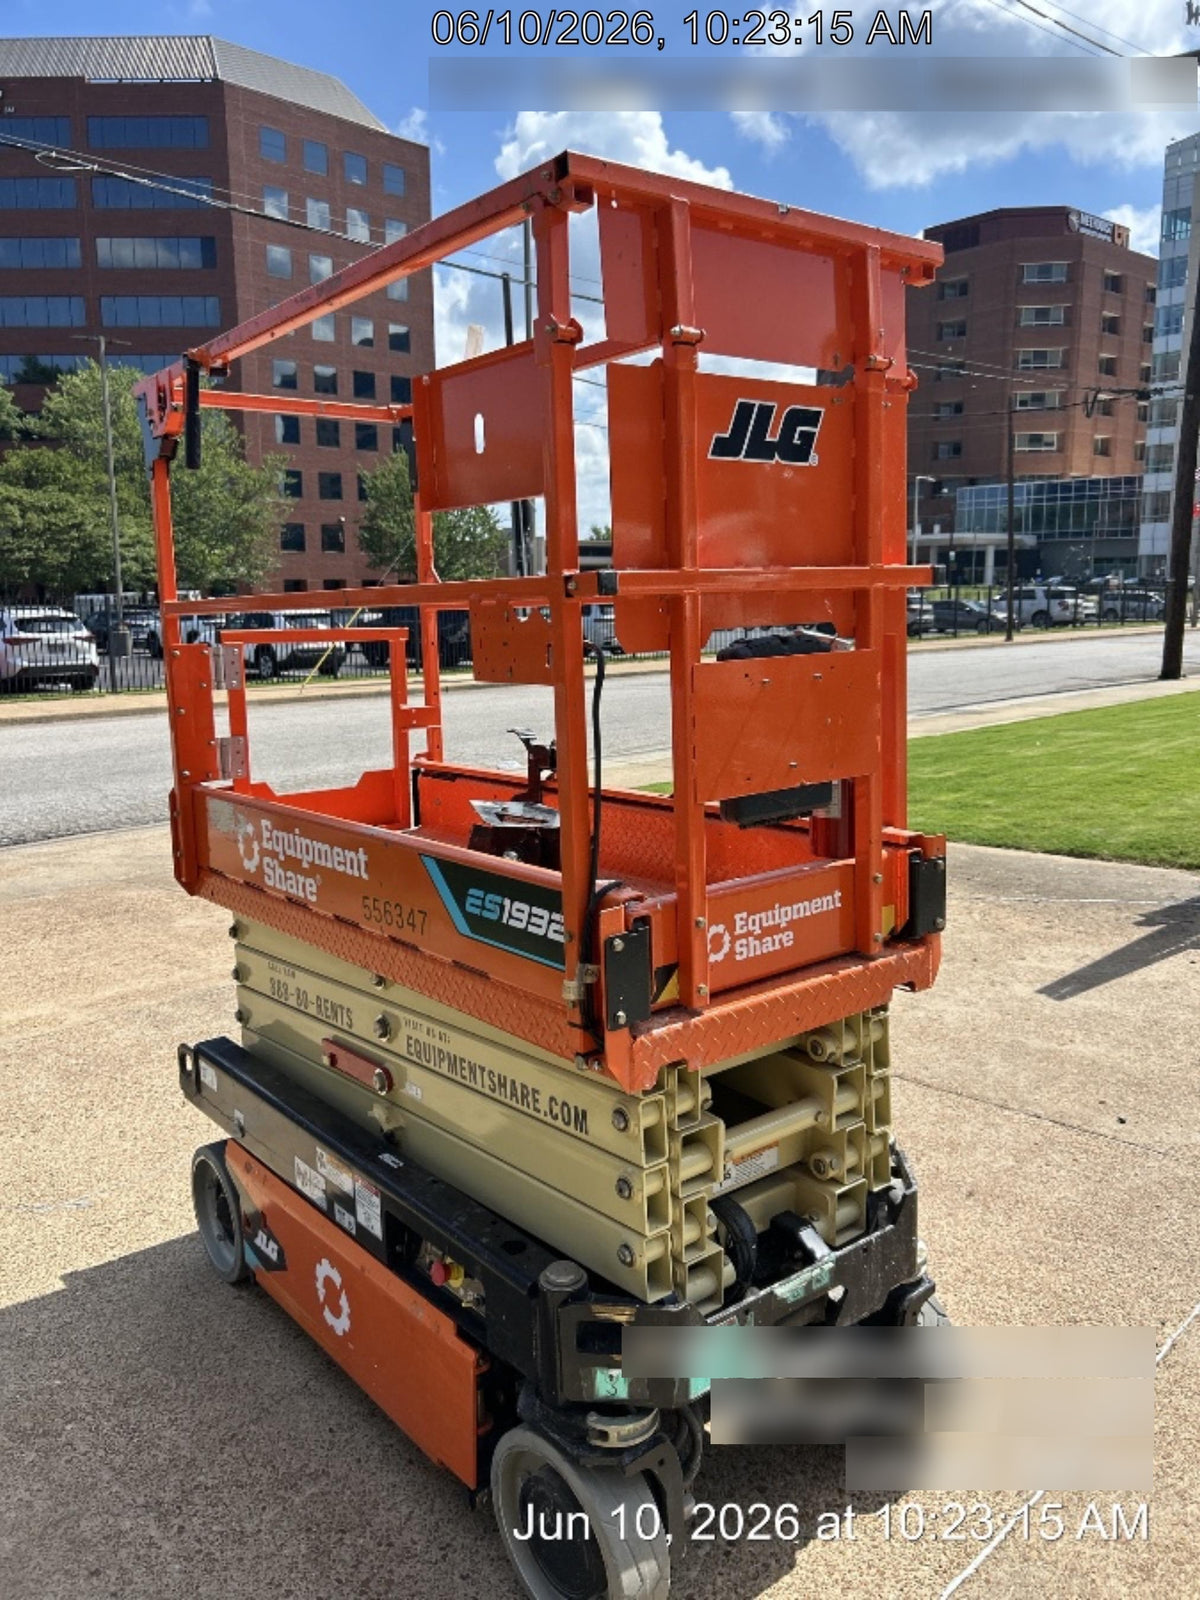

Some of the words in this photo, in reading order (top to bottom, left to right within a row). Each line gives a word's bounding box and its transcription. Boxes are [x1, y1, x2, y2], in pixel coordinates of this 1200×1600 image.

[707, 398, 825, 466] JLG
[261, 819, 369, 880] Equipment
[362, 895, 427, 936] 556347
[465, 888, 565, 943] ES1932
[734, 889, 842, 935] Equipment
[735, 930, 794, 961] Share
[406, 1034, 590, 1135] EQUIPMENTSHARE.COM
[254, 1229, 279, 1262] JLG
